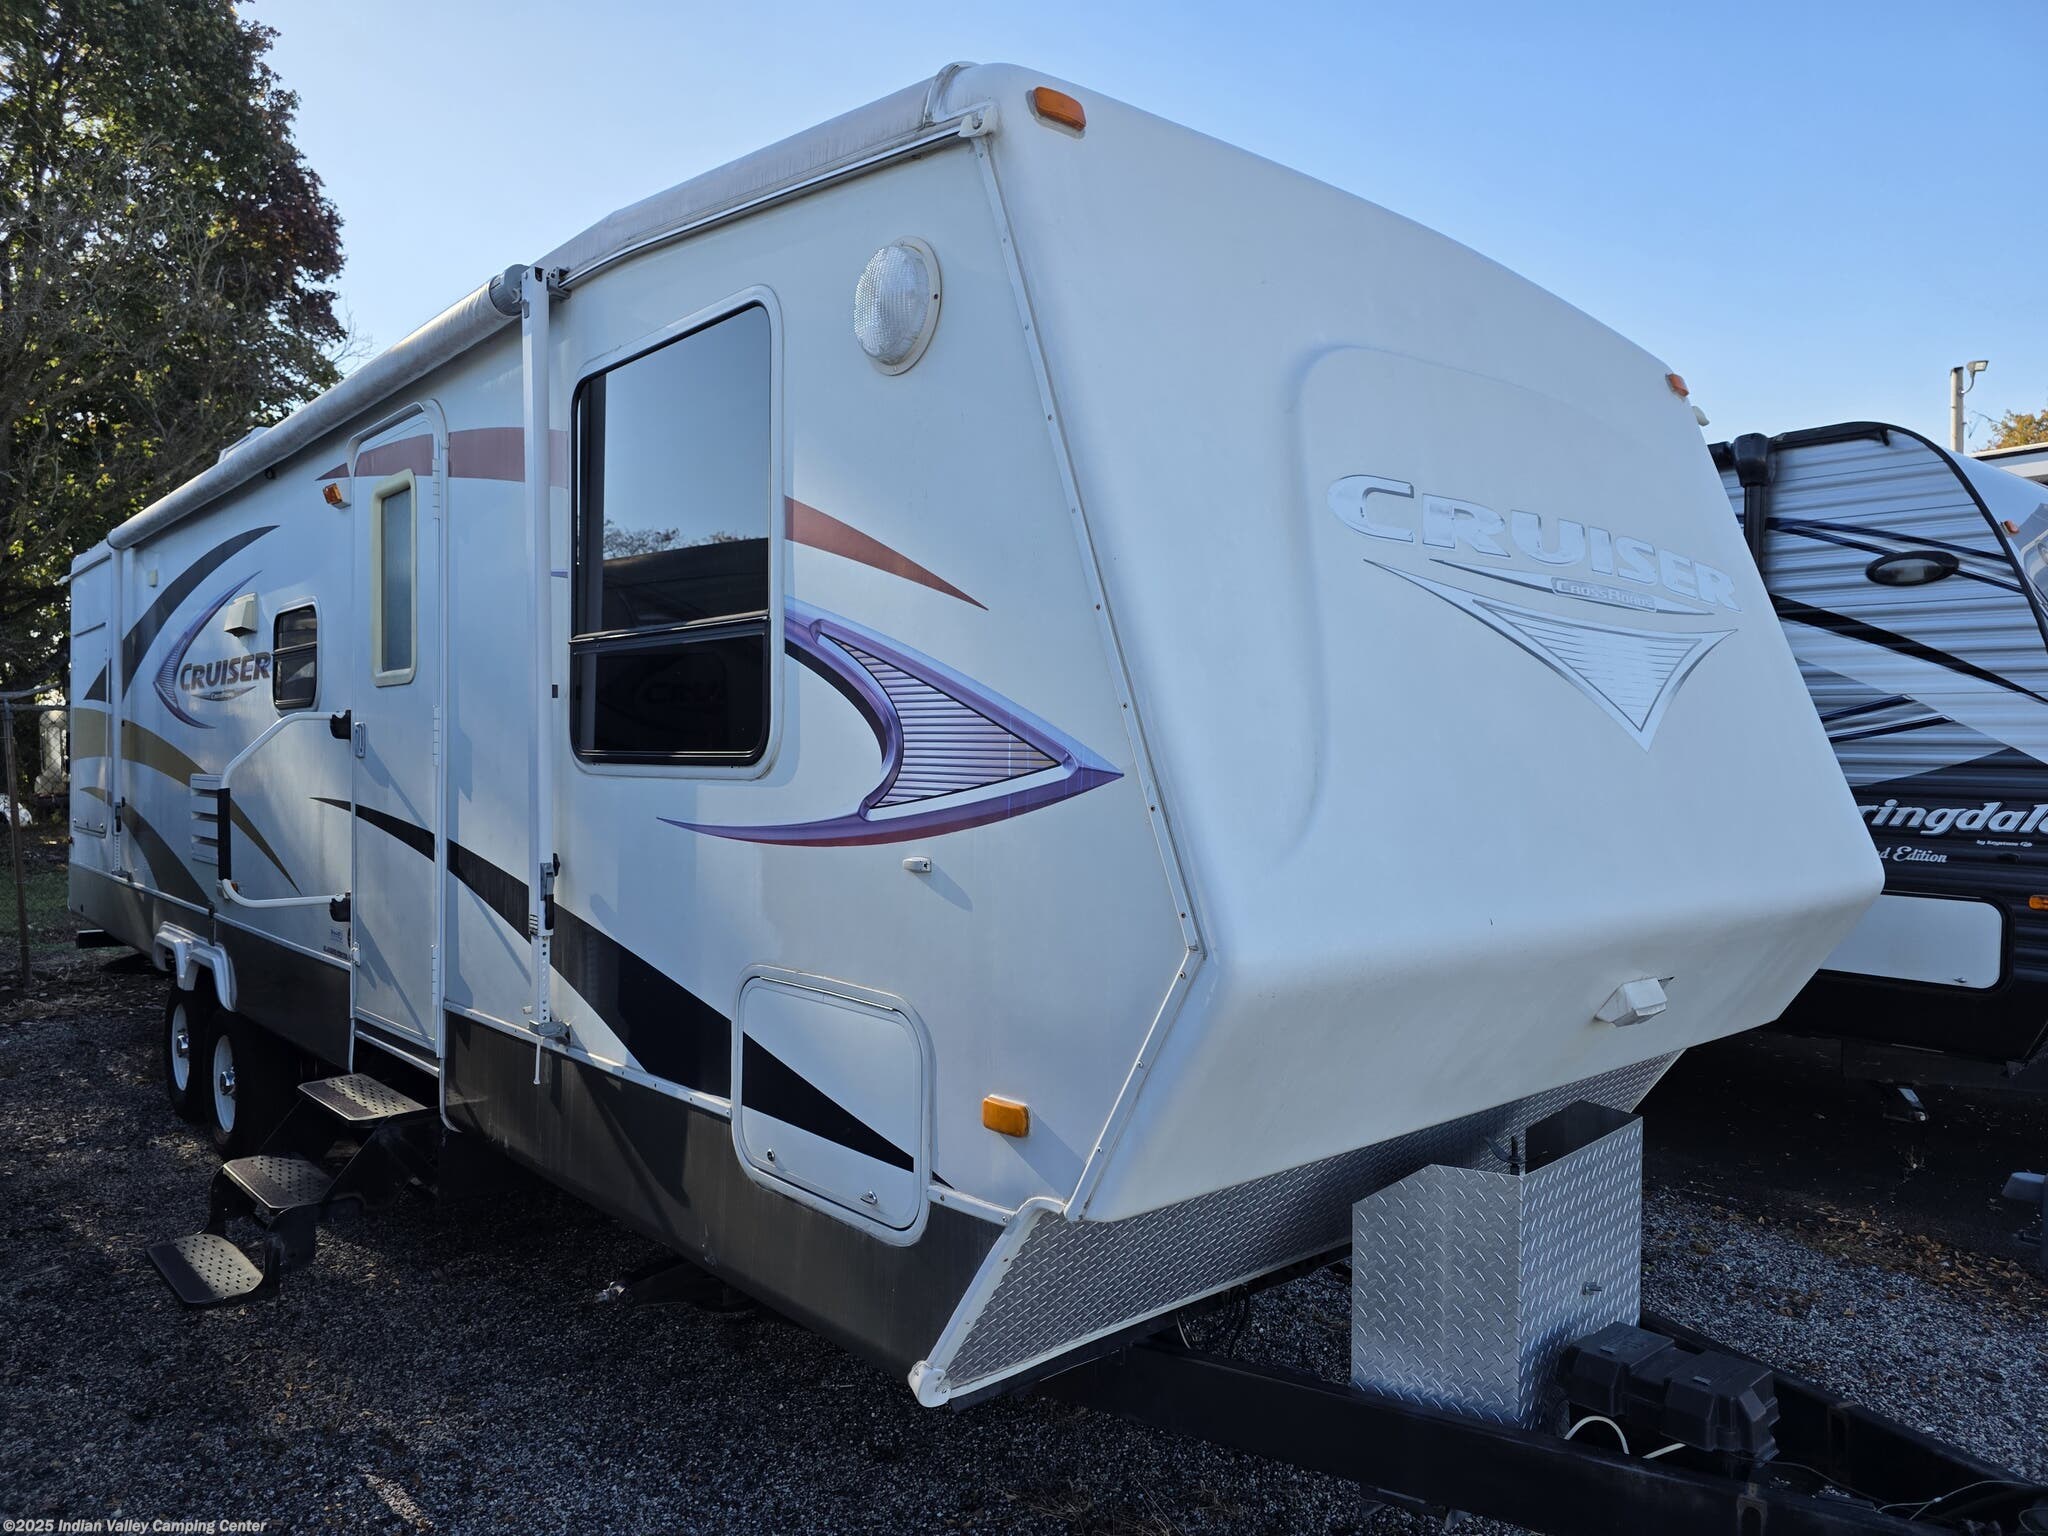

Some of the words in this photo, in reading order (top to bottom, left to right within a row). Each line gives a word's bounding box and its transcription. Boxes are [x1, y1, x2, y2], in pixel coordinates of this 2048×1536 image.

[1327, 474, 1742, 613] CRUISER
[180, 652, 271, 690] CRUISER
[1893, 846, 1948, 863] Edition
